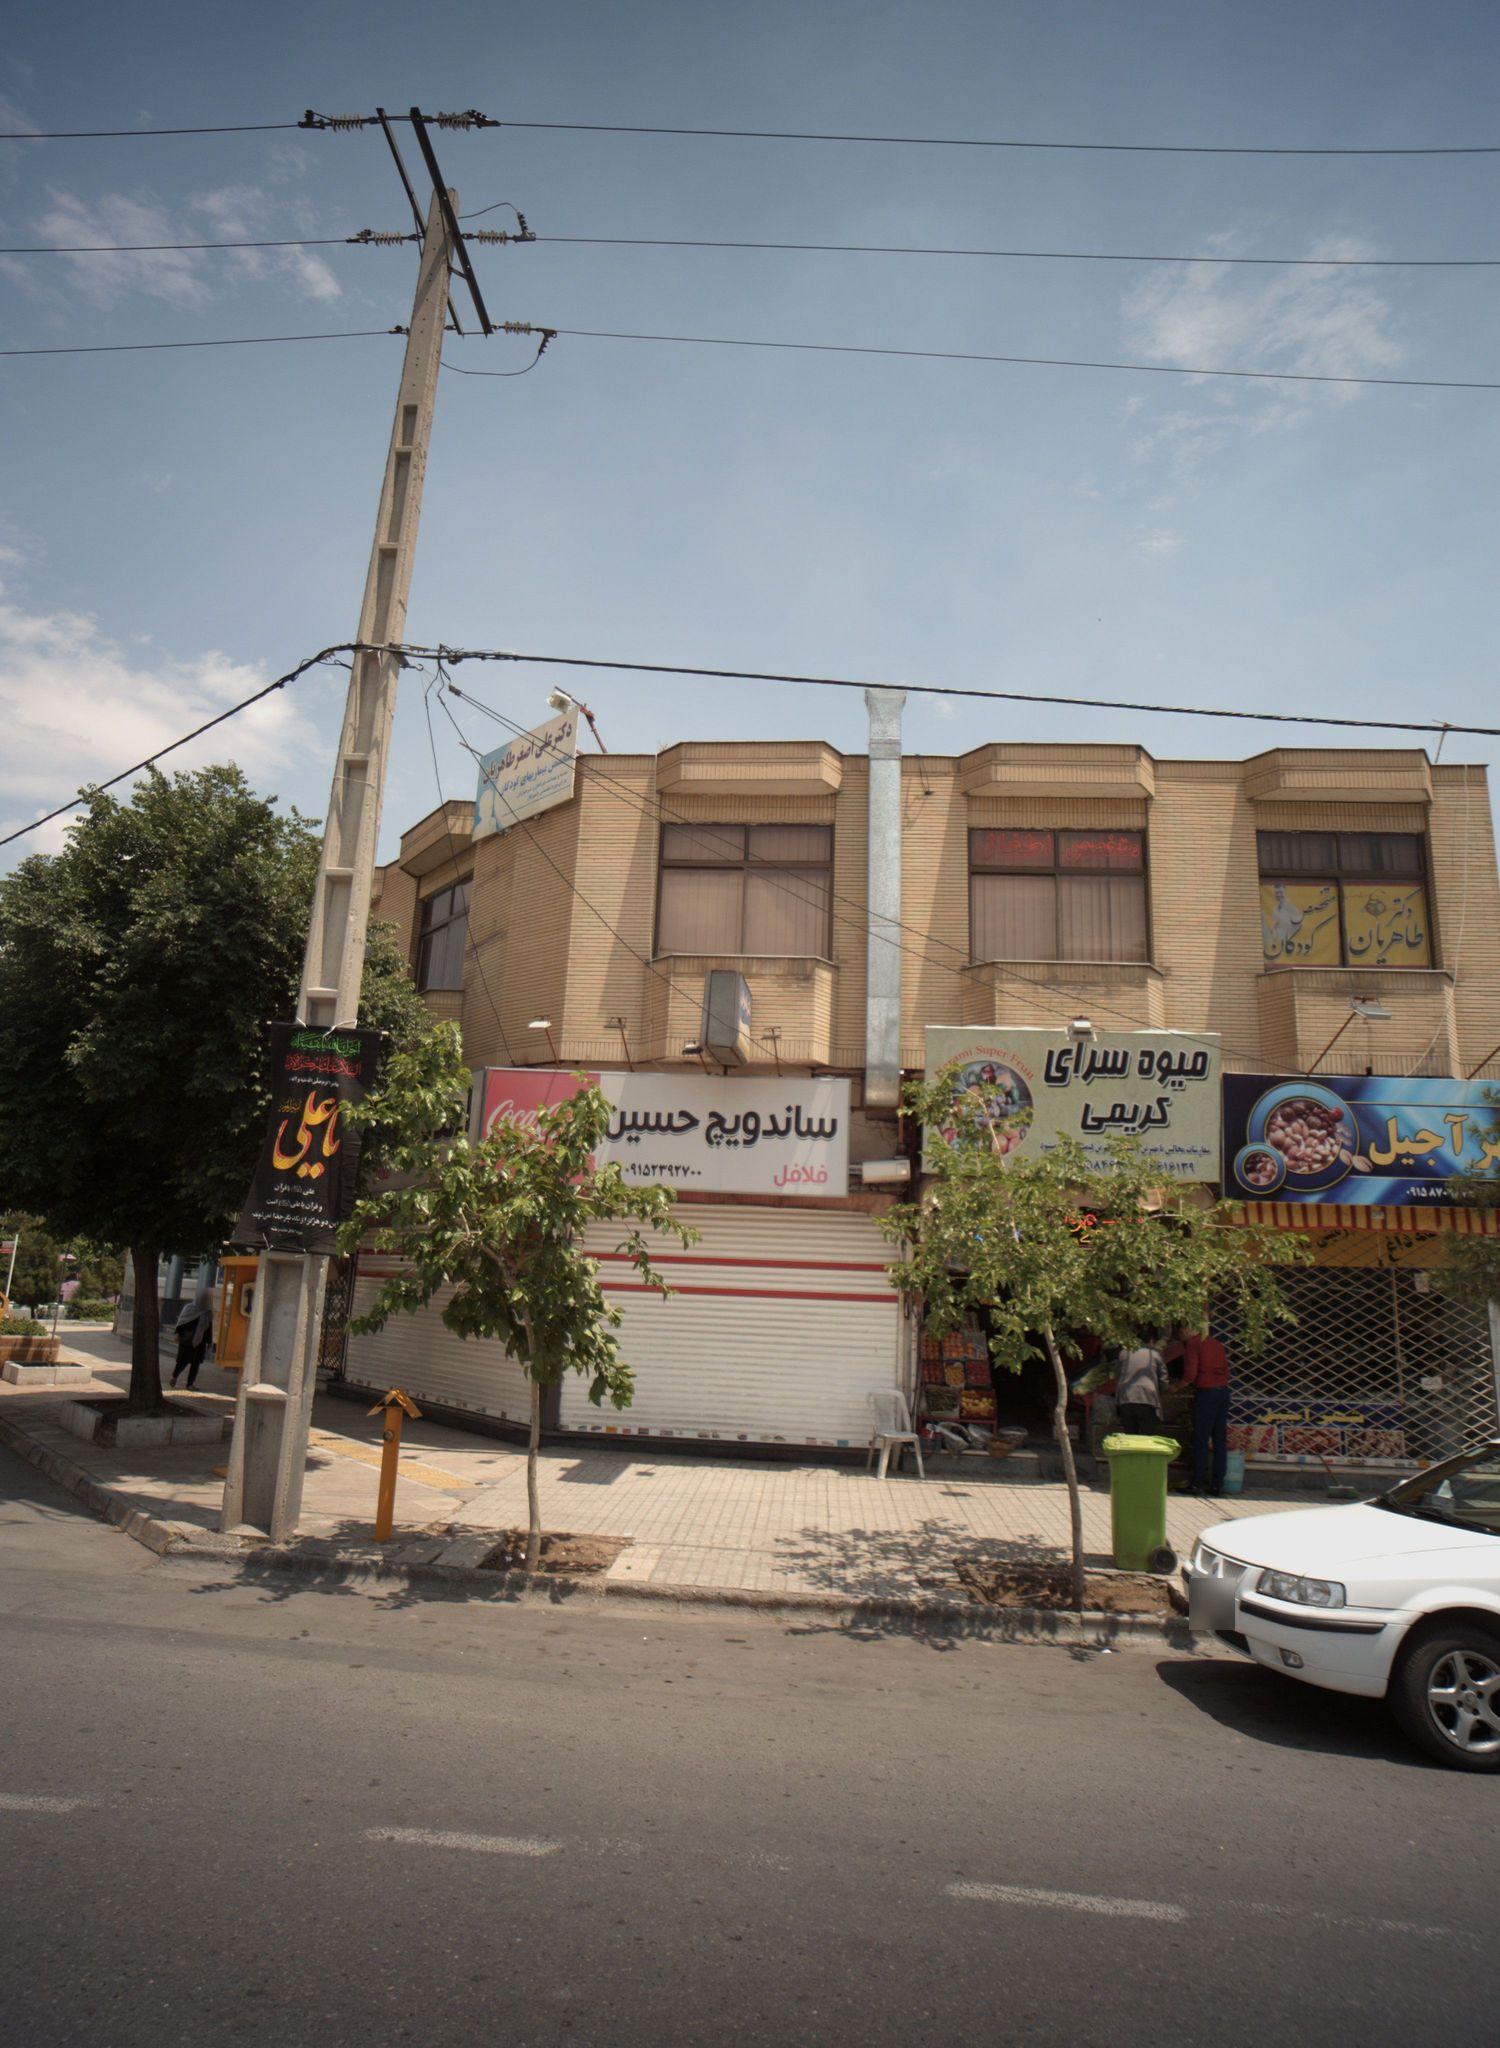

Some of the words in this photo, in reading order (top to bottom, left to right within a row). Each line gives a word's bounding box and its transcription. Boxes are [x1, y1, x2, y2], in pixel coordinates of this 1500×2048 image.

[1386, 887, 1424, 927] دکتر
[1264, 911, 1338, 960] کودکان
[1349, 922, 1424, 965] طاهریان
[1044, 1041, 1131, 1087] سرای
[1137, 1049, 1210, 1090] میوه
[605, 1104, 700, 1143] حسین
[705, 1105, 838, 1148] ساندویچ
[1081, 1097, 1173, 1135] کریمی
[1369, 1113, 1469, 1166] آجیل
[773, 1163, 828, 1188] فلافل
